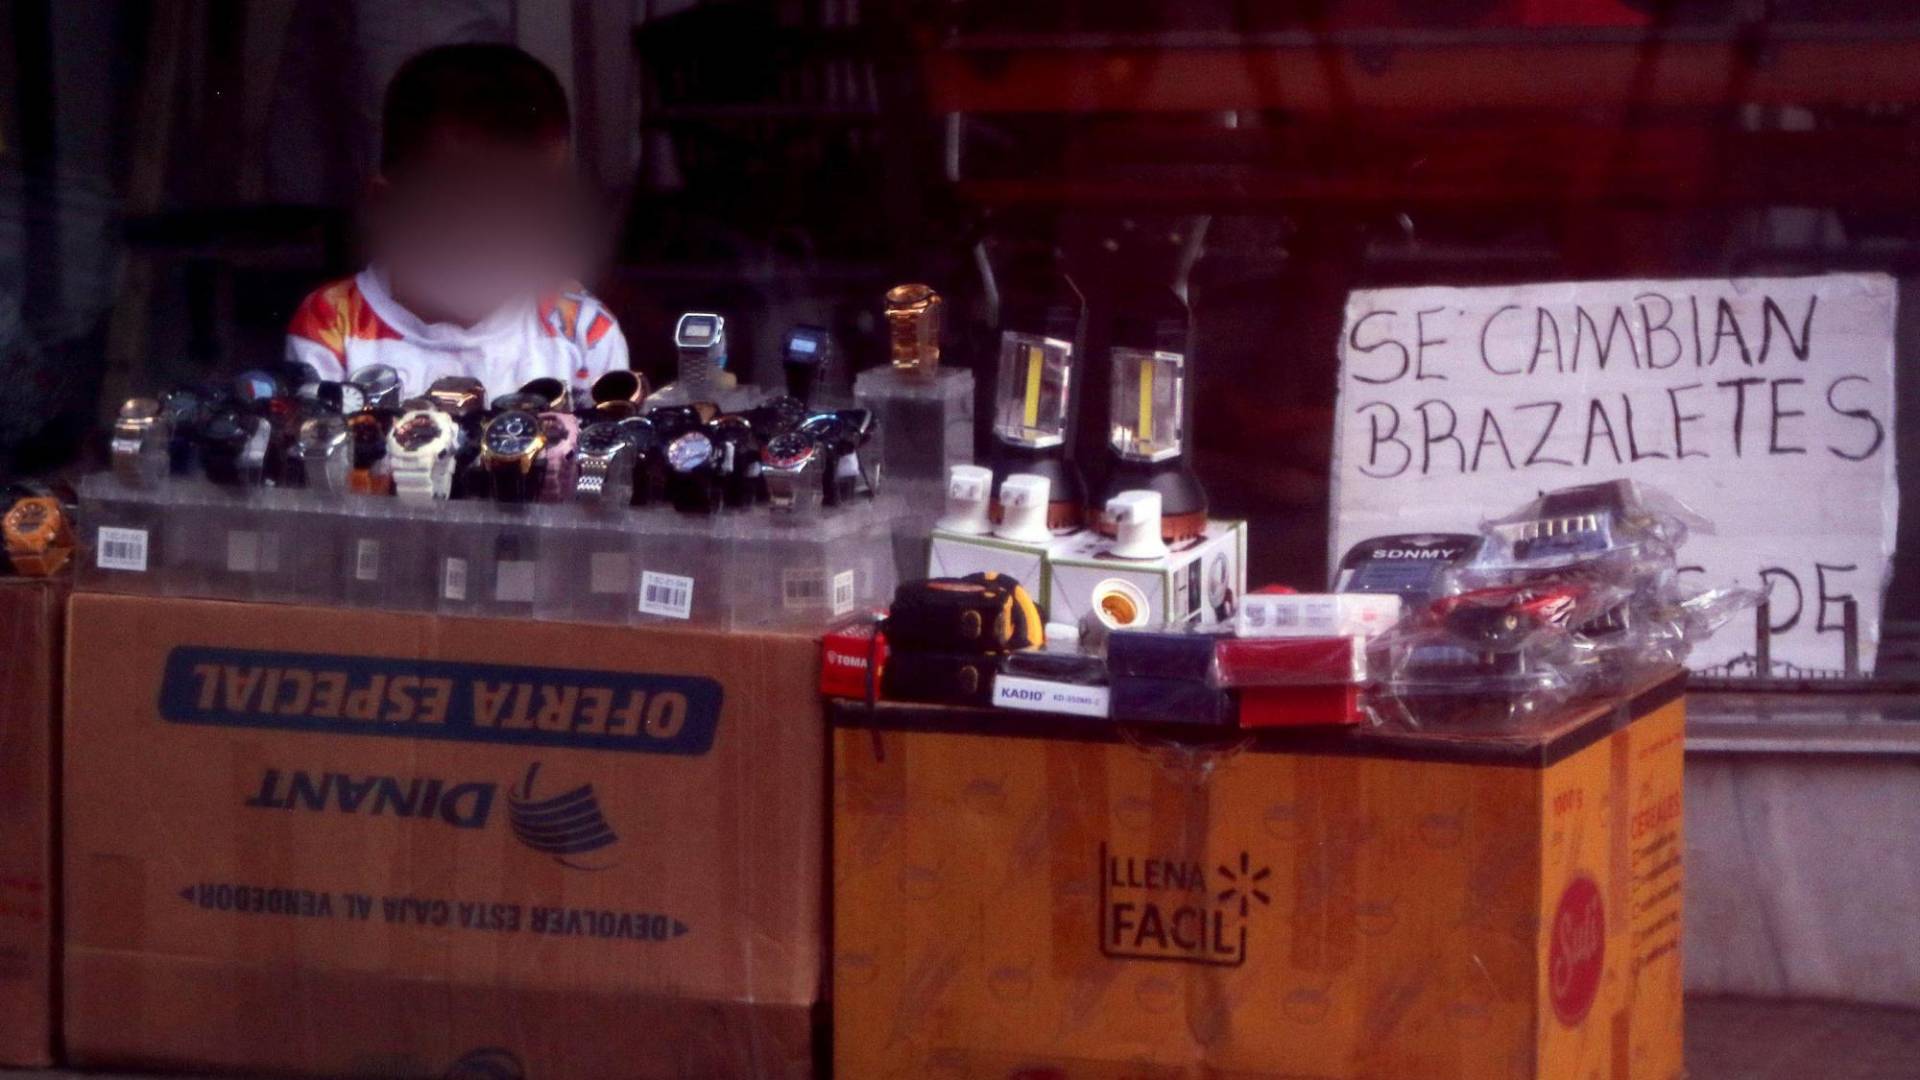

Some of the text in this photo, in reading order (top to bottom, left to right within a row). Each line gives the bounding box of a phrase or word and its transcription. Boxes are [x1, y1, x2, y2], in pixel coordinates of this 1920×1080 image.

[1350, 293, 1818, 384] SE CAMBIAN
[1356, 375, 1885, 479] BRAZALETES
[193, 663, 688, 738] OFERTA ESPECIAL
[1001, 687, 1043, 702] KADIO
[244, 768, 498, 829] DINANT
[1110, 856, 1208, 893] LLENA
[199, 883, 669, 941] DEVOLVER ESTA CAJA AL VENDEDOR
[1111, 902, 1235, 954] FACIL
